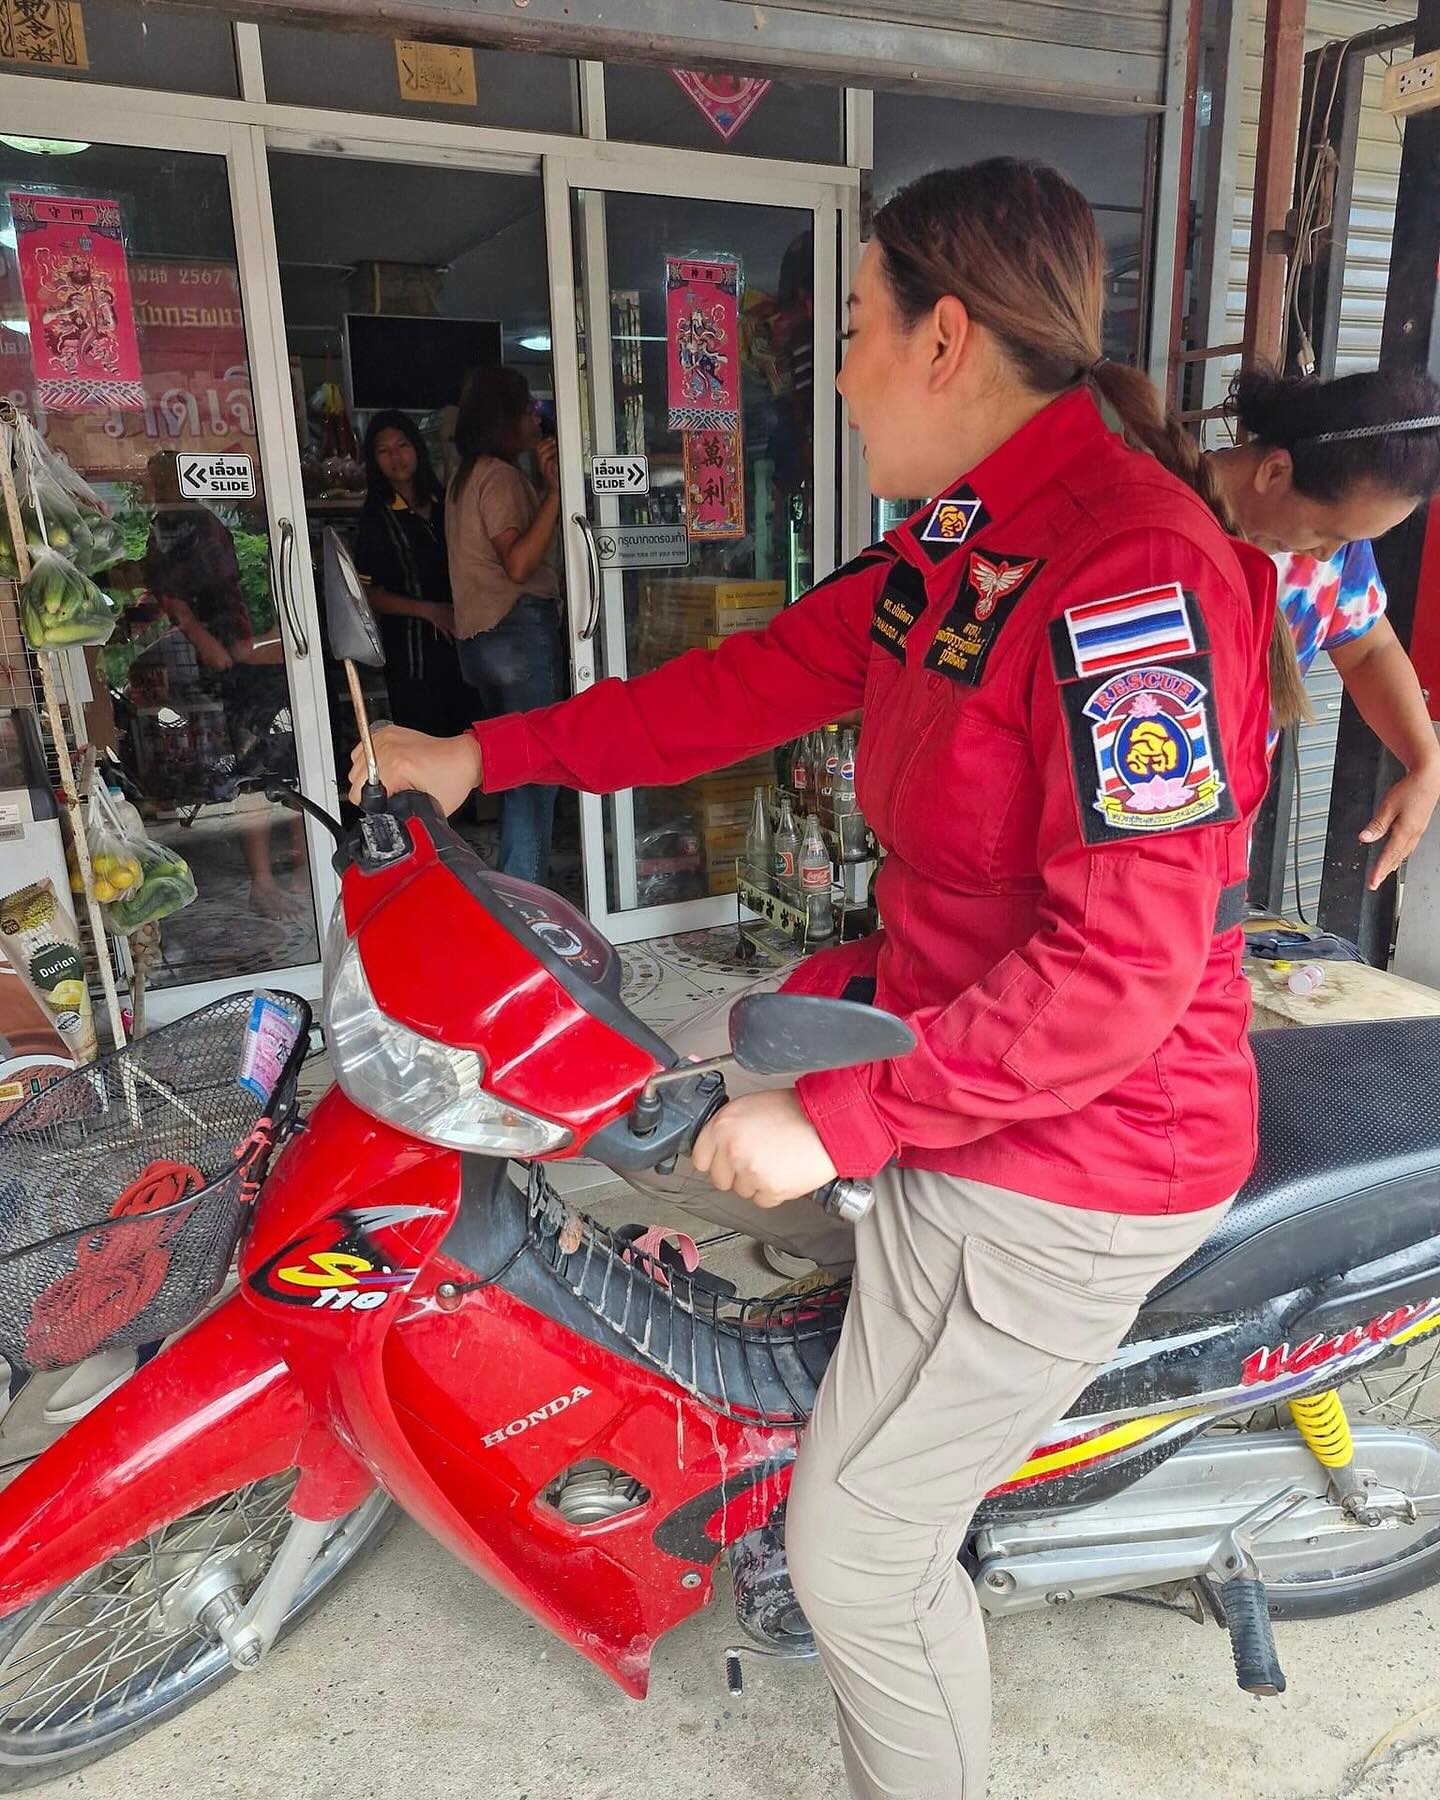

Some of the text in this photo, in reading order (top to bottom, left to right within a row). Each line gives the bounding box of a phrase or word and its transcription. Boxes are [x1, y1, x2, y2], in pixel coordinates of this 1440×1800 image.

[178, 268, 222, 285] 2567
[209, 458, 247, 476] เลื่อน
[595, 459, 624, 475] เลื่อน
[211, 481, 249, 491] SLIDE
[596, 479, 625, 488] SLIDE
[1093, 672, 1193, 708] RESCUE
[834, 791, 856, 801] PEP
[39, 956, 77, 979] Durian
[311, 1288, 388, 1310] 110
[480, 1385, 592, 1448] HONDA
